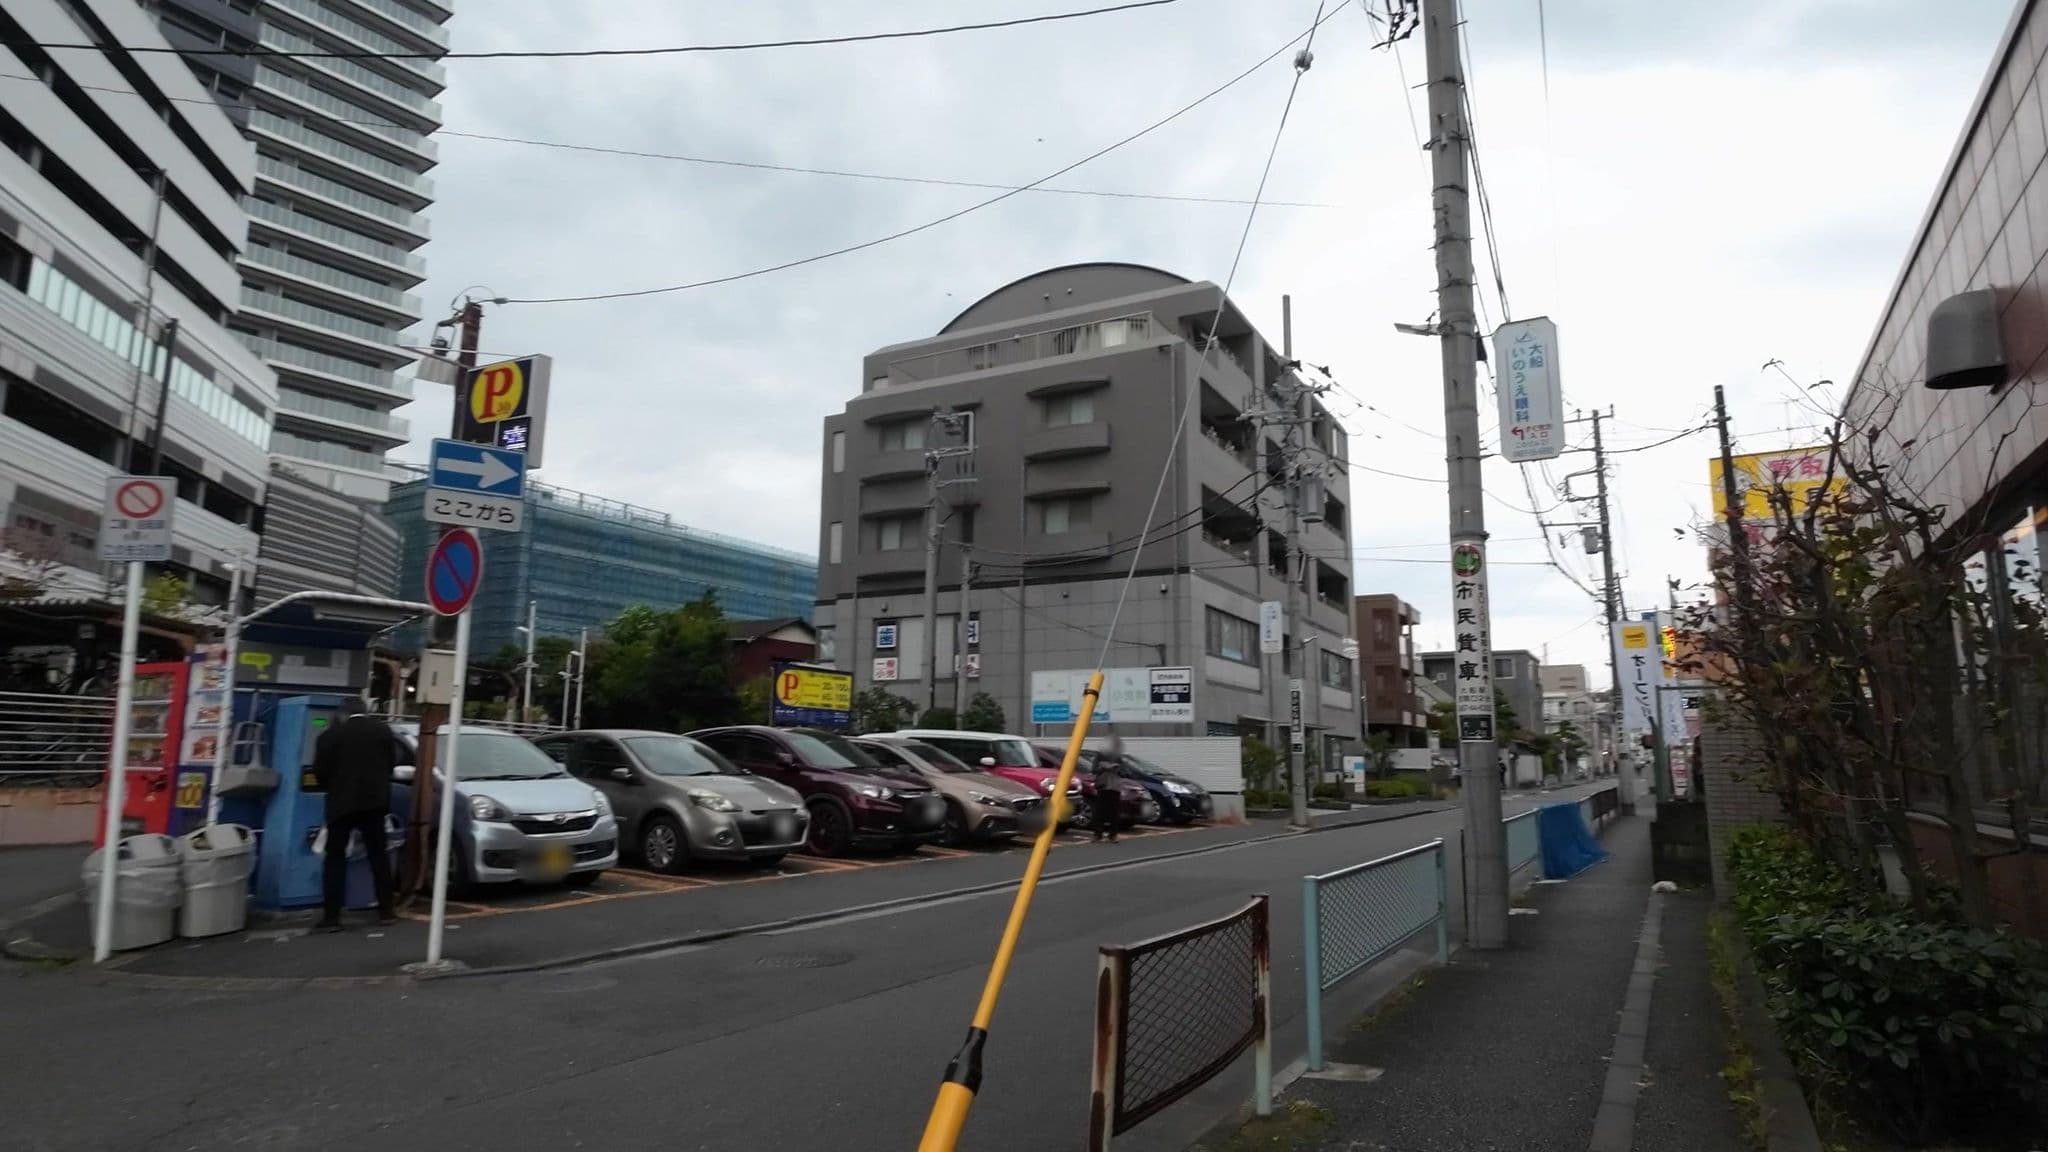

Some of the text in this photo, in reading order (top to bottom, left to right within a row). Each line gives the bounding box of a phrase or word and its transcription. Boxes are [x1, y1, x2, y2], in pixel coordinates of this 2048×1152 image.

[1528, 344, 1543, 368] 大船
[479, 367, 513, 419] P
[1511, 346, 1529, 423] いのうえ眼科
[433, 497, 515, 524] ここから
[783, 672, 799, 700] P
